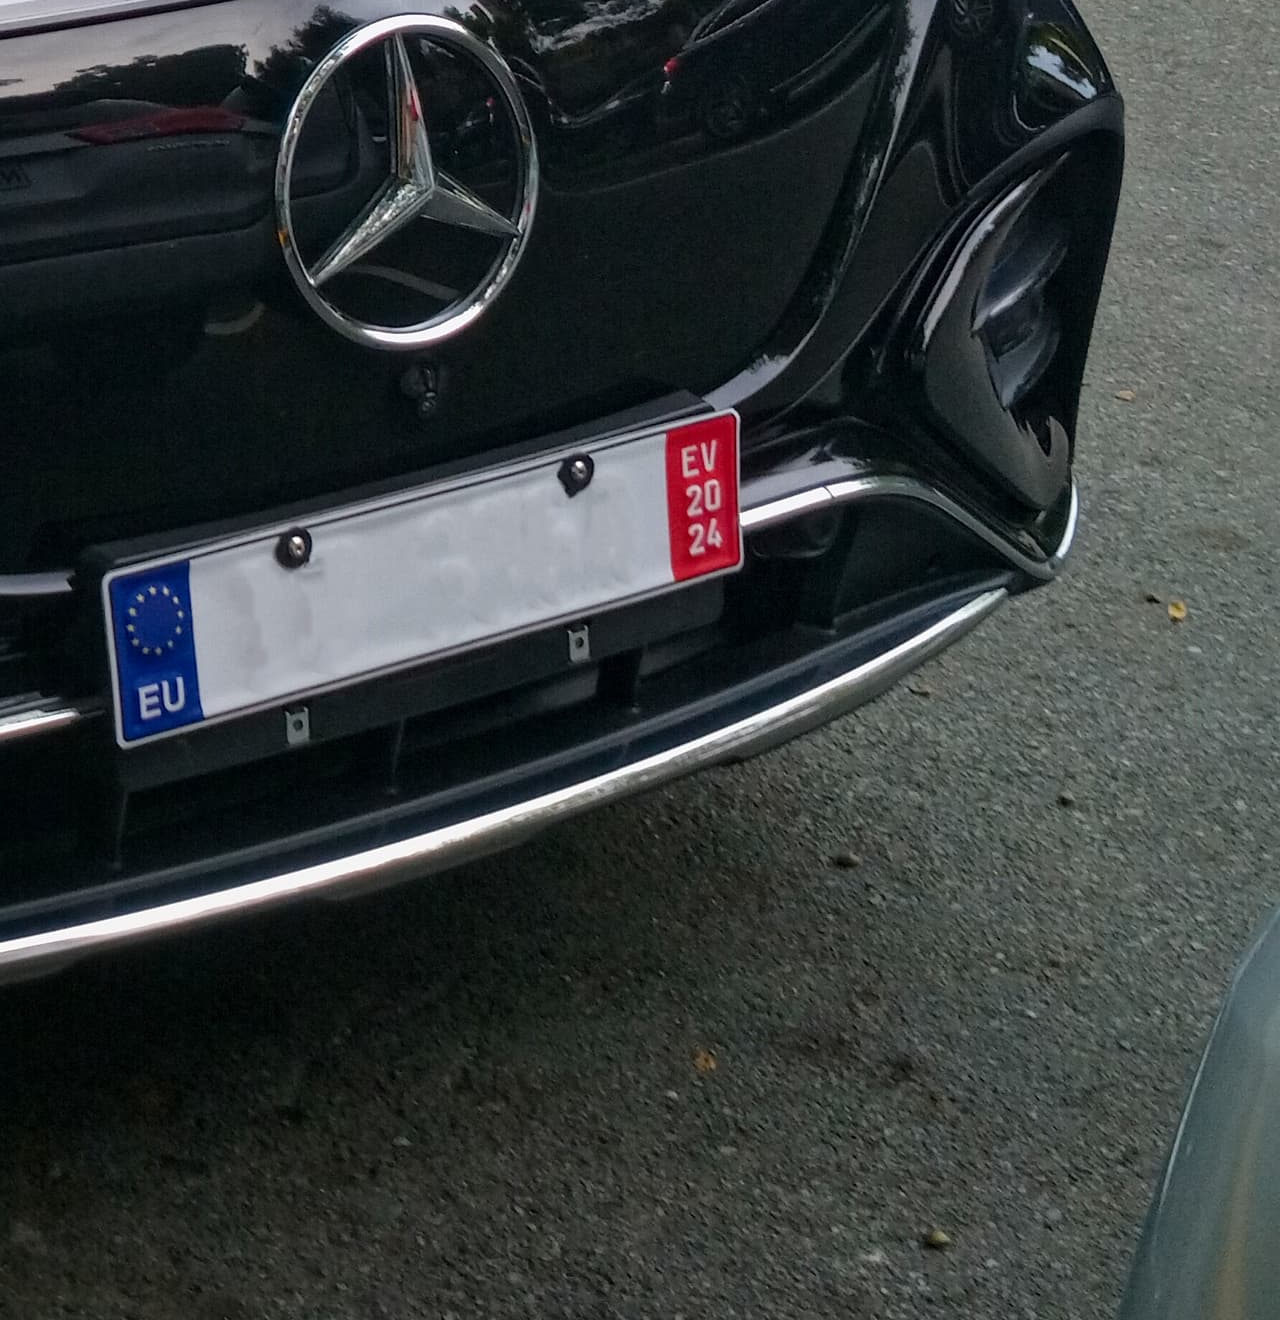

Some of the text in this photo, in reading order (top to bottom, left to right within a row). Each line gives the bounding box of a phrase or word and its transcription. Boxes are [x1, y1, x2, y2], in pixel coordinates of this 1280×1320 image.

[681, 440, 718, 478] EV
[686, 479, 721, 517] 20
[688, 518, 723, 556] 24
[138, 676, 186, 720] EU
